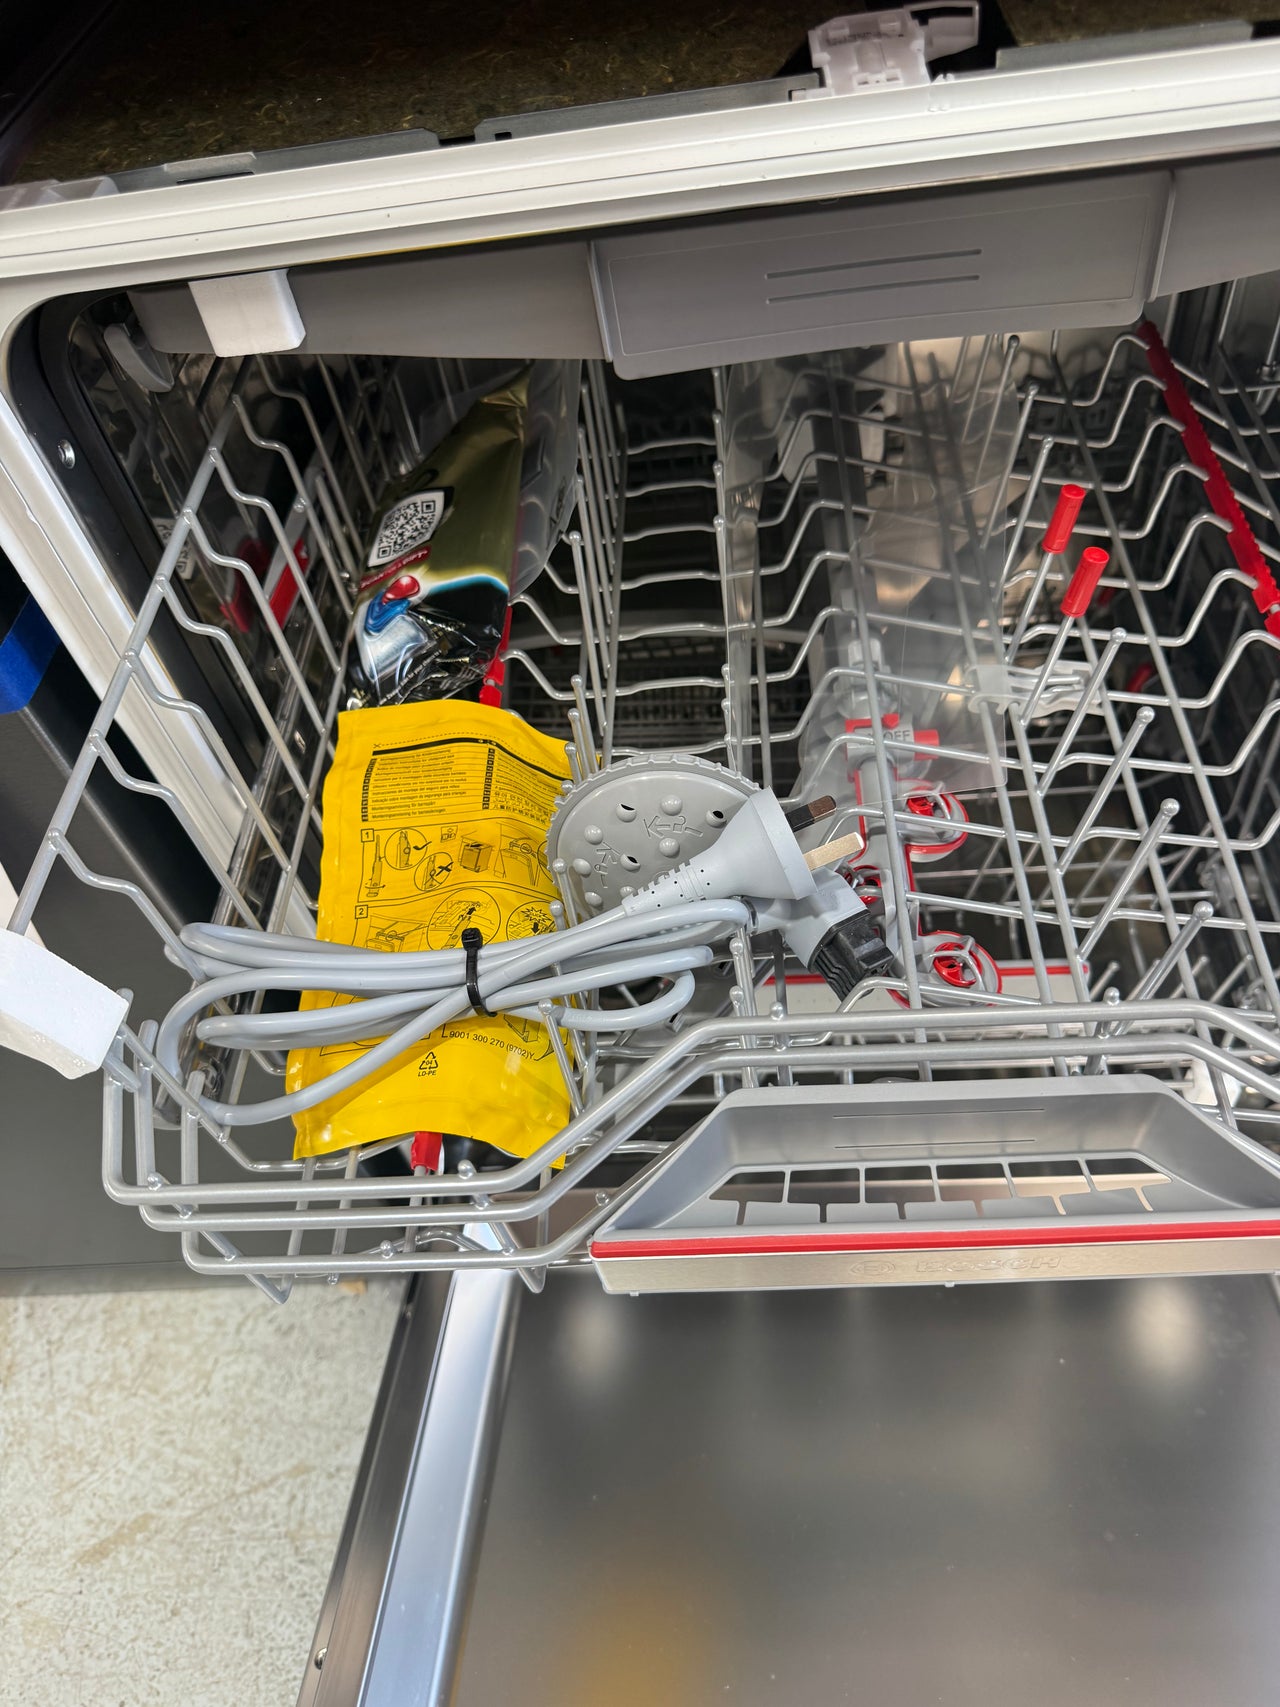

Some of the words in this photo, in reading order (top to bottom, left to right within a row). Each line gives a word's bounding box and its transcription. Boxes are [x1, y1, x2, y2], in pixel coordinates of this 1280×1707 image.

[883, 730, 910, 742] OFF
[359, 908, 364, 916] 2
[449, 1030, 470, 1039] 9001
[472, 1034, 488, 1043] 300
[490, 1038, 505, 1048] 270
[916, 1256, 1061, 1273] BOSCH
